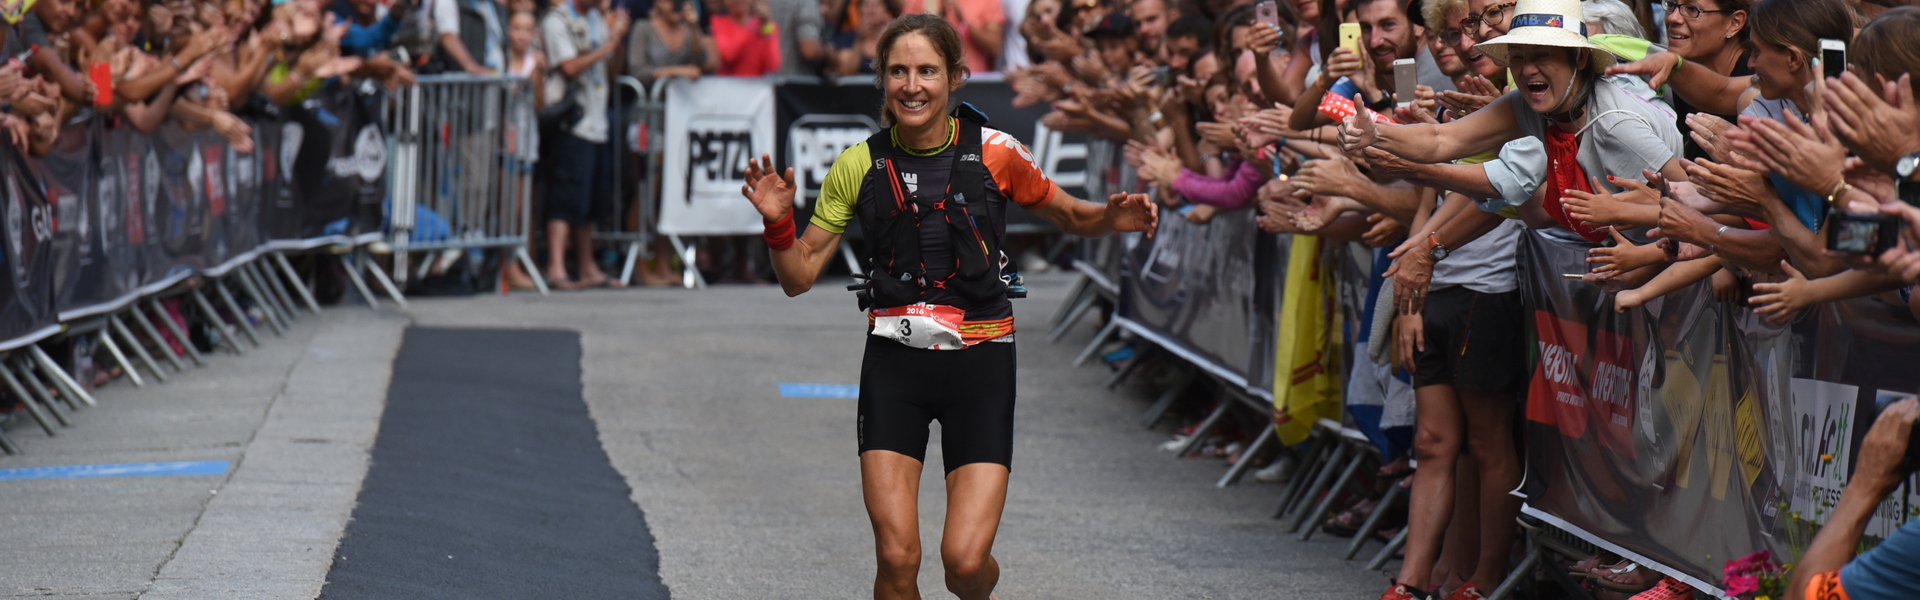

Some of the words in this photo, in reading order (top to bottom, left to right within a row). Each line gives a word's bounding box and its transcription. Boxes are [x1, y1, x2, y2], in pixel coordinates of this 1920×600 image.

[906, 307, 925, 315] 2016
[900, 318, 912, 337] 3
[933, 314, 958, 329] Columbia
